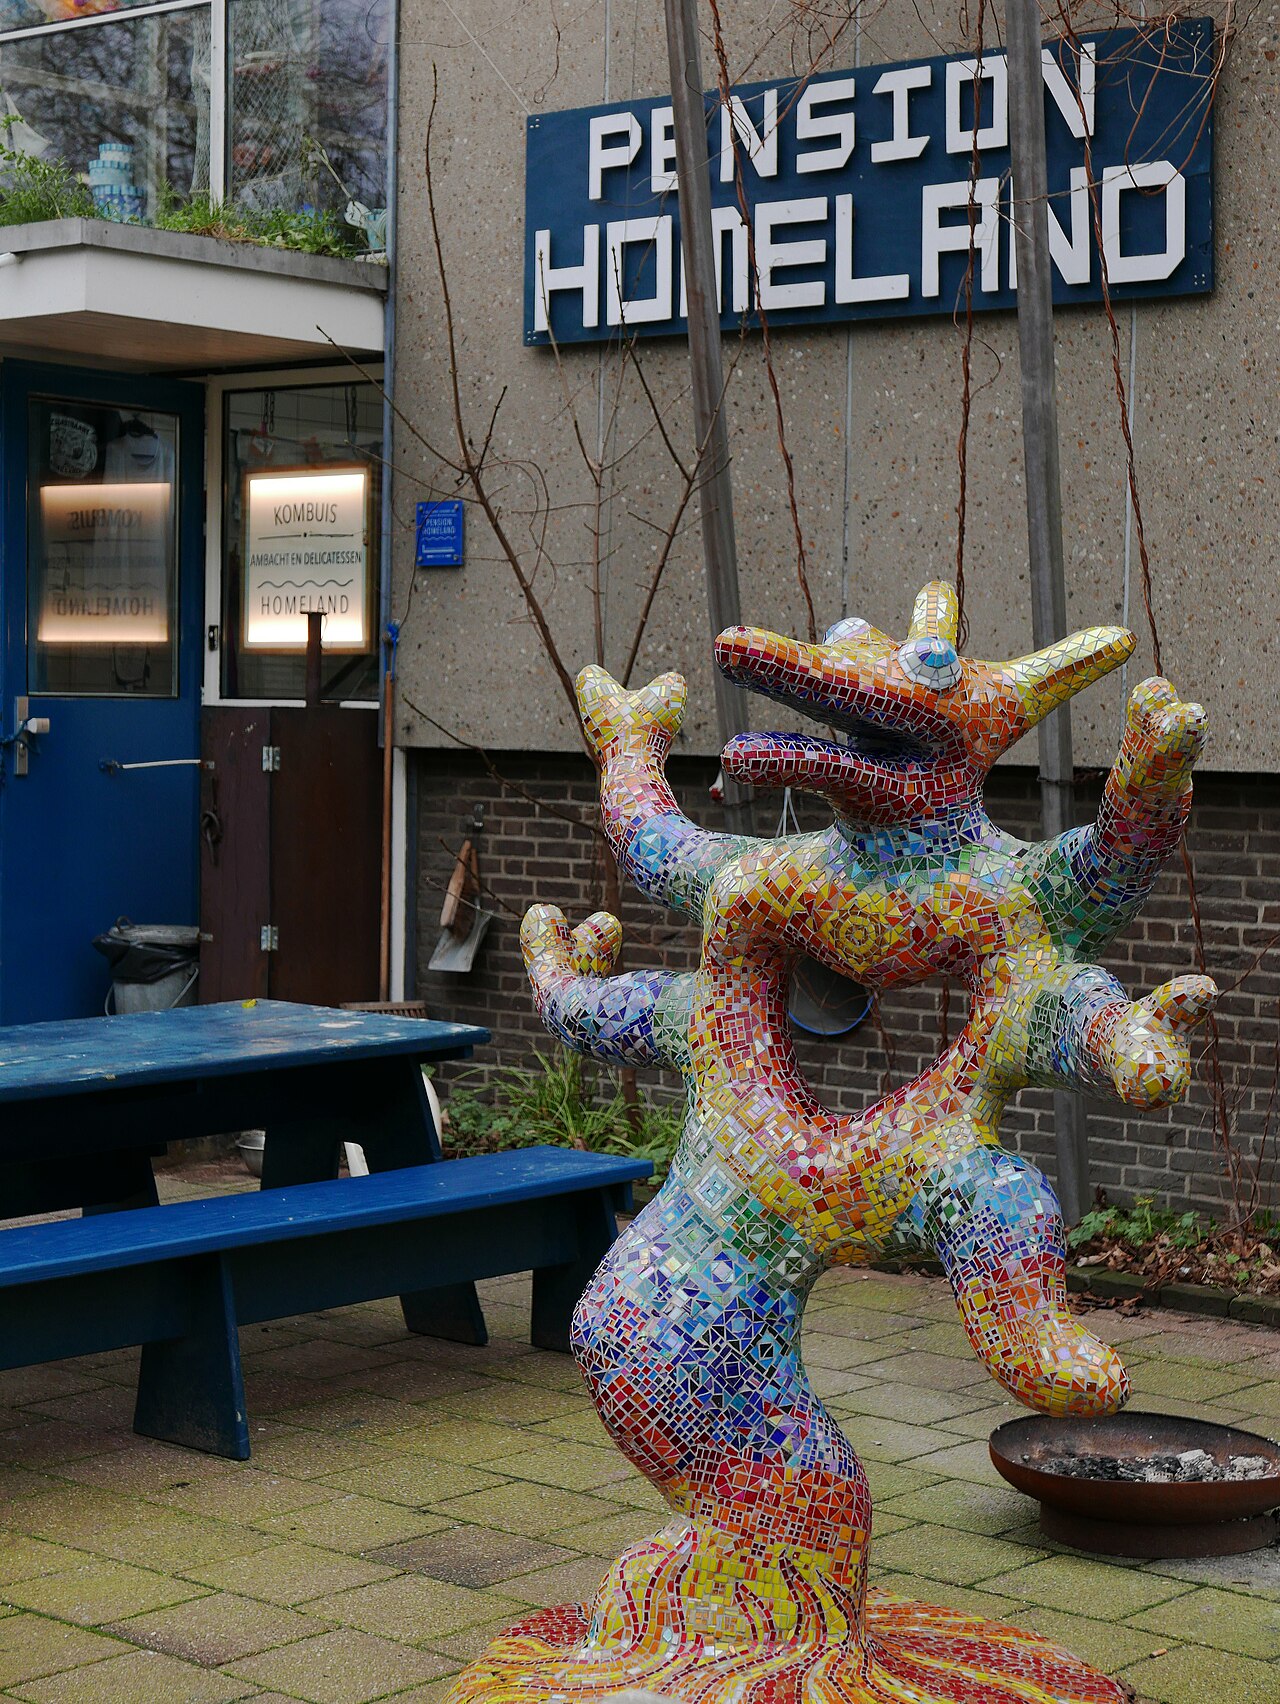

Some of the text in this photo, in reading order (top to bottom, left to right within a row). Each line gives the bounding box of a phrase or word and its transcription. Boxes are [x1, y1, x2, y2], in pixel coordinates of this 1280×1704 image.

[589, 42, 1096, 200] PENSION
[534, 160, 1186, 332] HOMELAND
[274, 502, 338, 526] KOMBUIS
[250, 550, 362, 567] AMBACHT EN DELICATESSEN
[261, 594, 350, 616] HOMELAND
